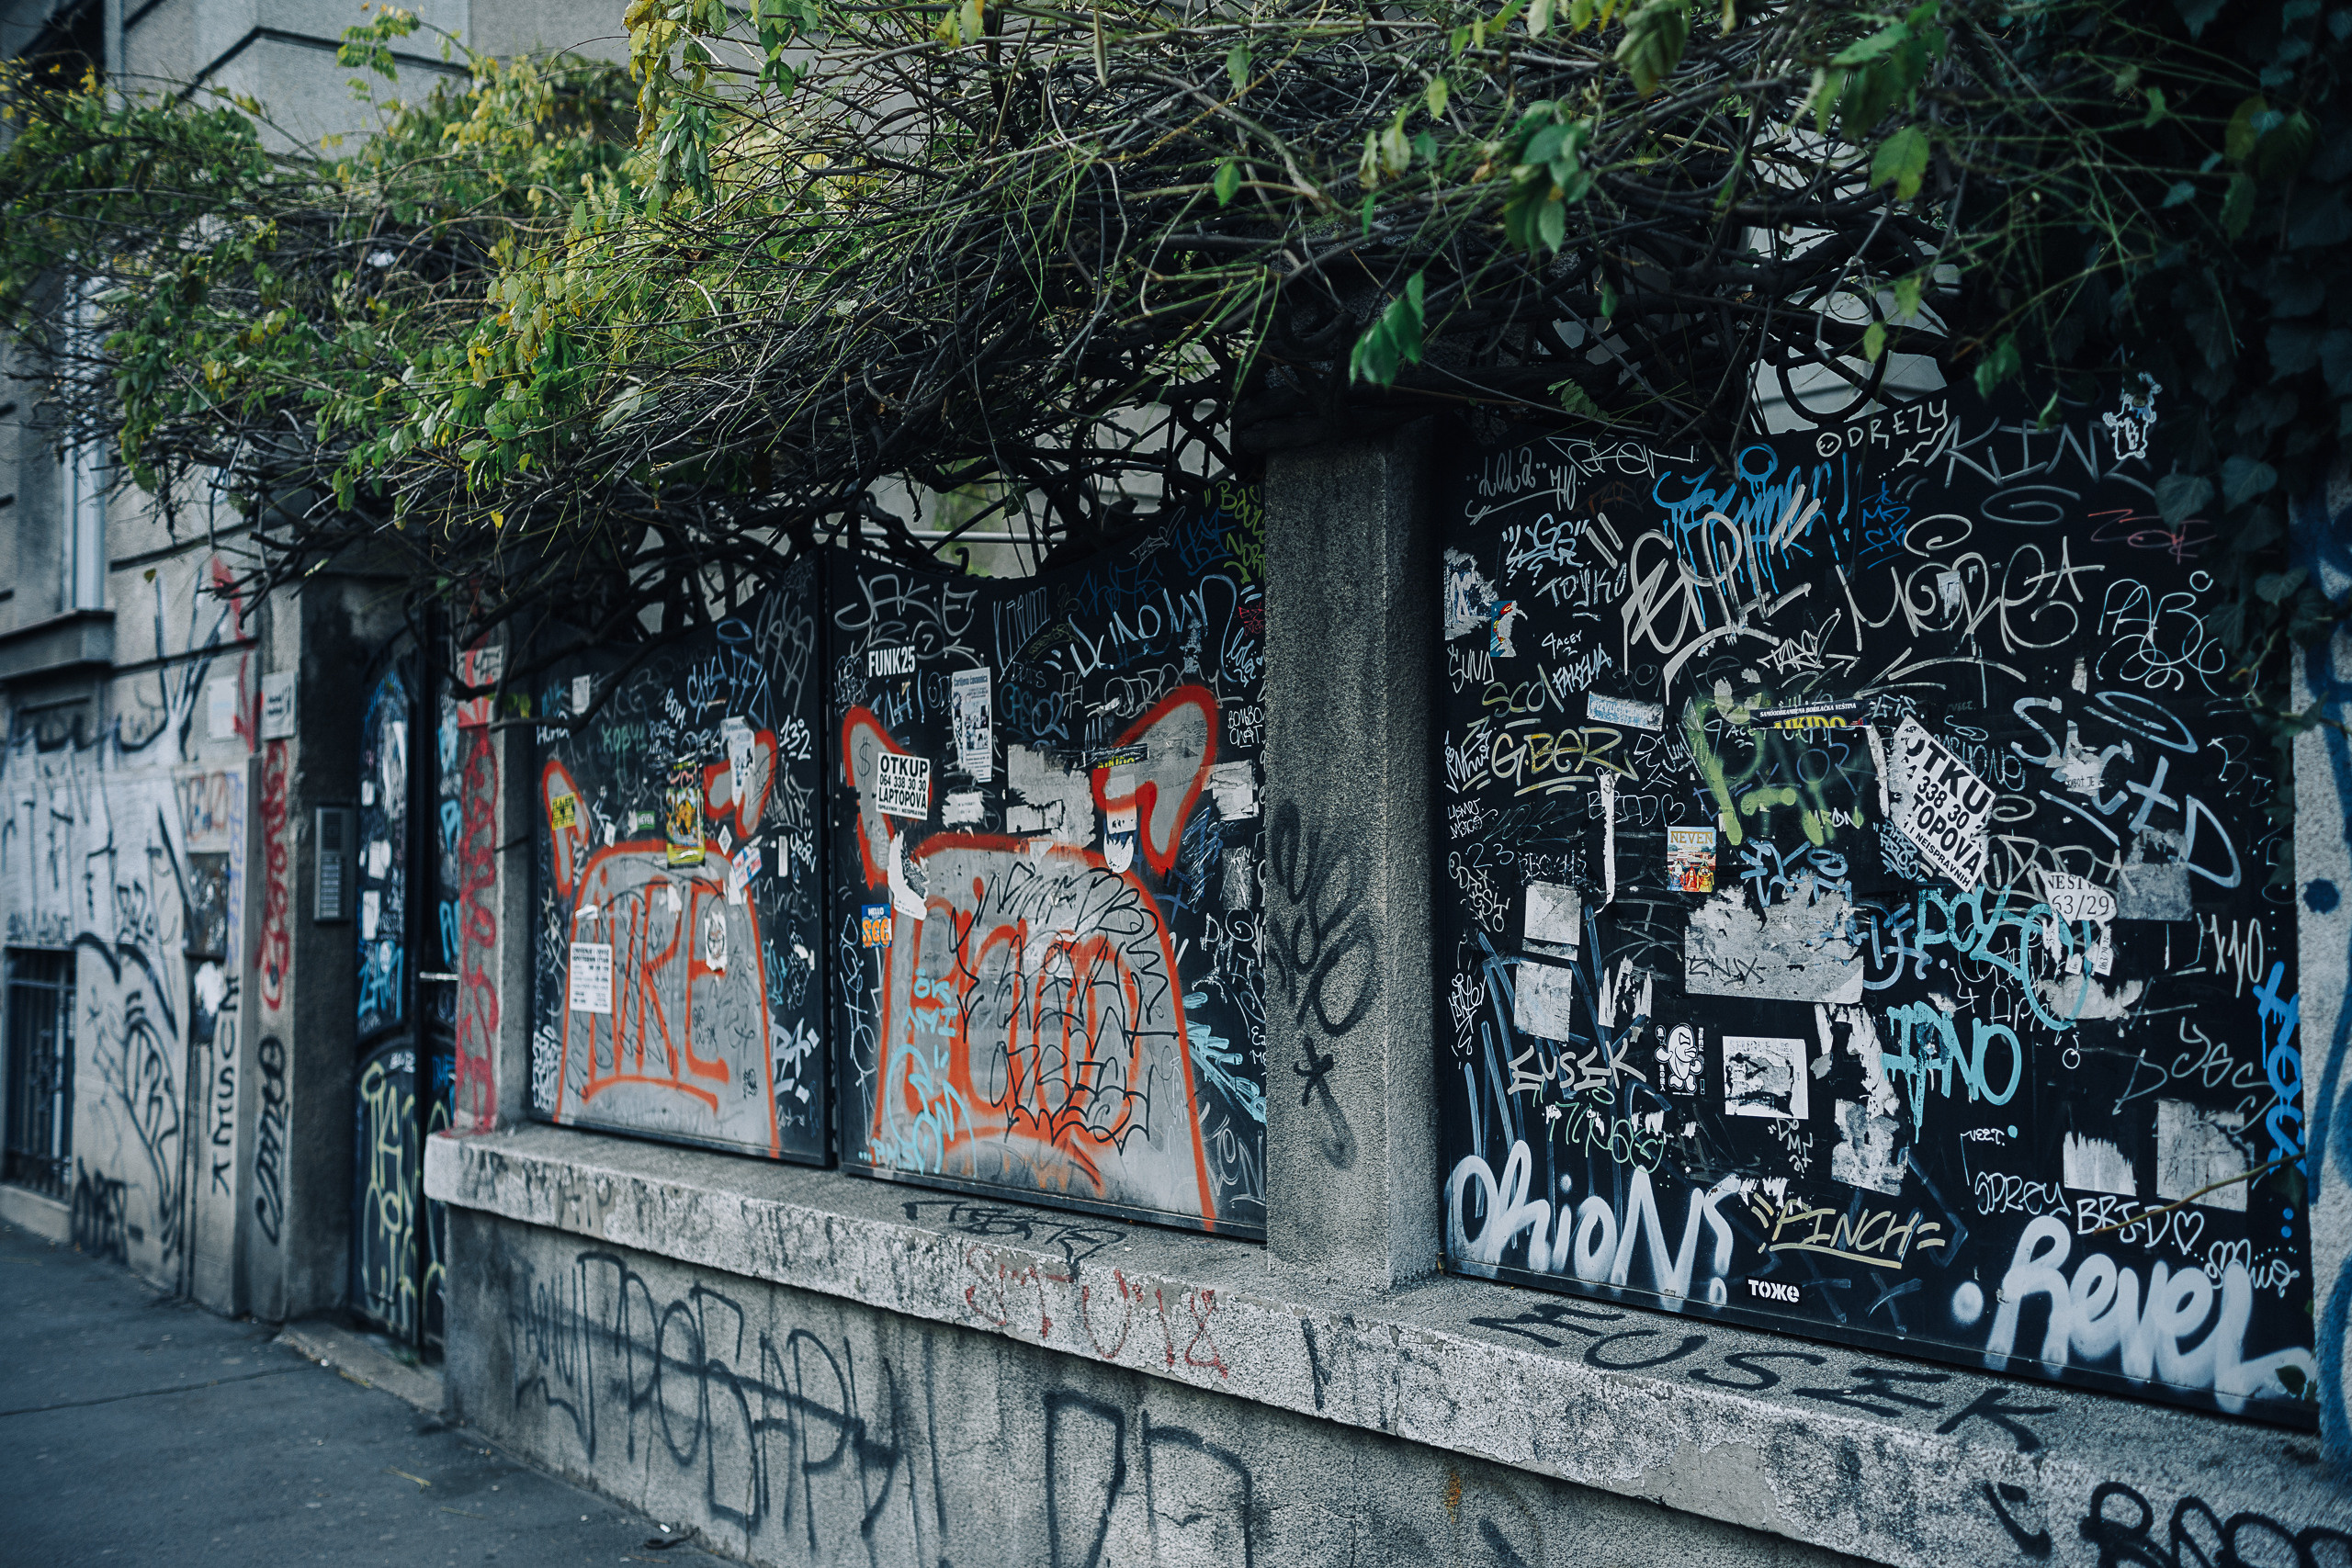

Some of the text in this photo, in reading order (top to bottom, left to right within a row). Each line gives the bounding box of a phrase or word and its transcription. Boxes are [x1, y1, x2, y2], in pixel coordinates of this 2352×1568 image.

[868, 645, 916, 678] FUNK25
[879, 754, 929, 779] OTKUP
[879, 773, 927, 793] 064 338 30 30
[1905, 738, 1992, 823] OTKU
[878, 787, 927, 810] LAPTOPOVA
[1917, 775, 1970, 830] 338 30
[1670, 830, 1713, 844] NEVEN
[1911, 793, 1983, 877] TOPOVA
[1915, 833, 1972, 887] NEISPRAVNIH
